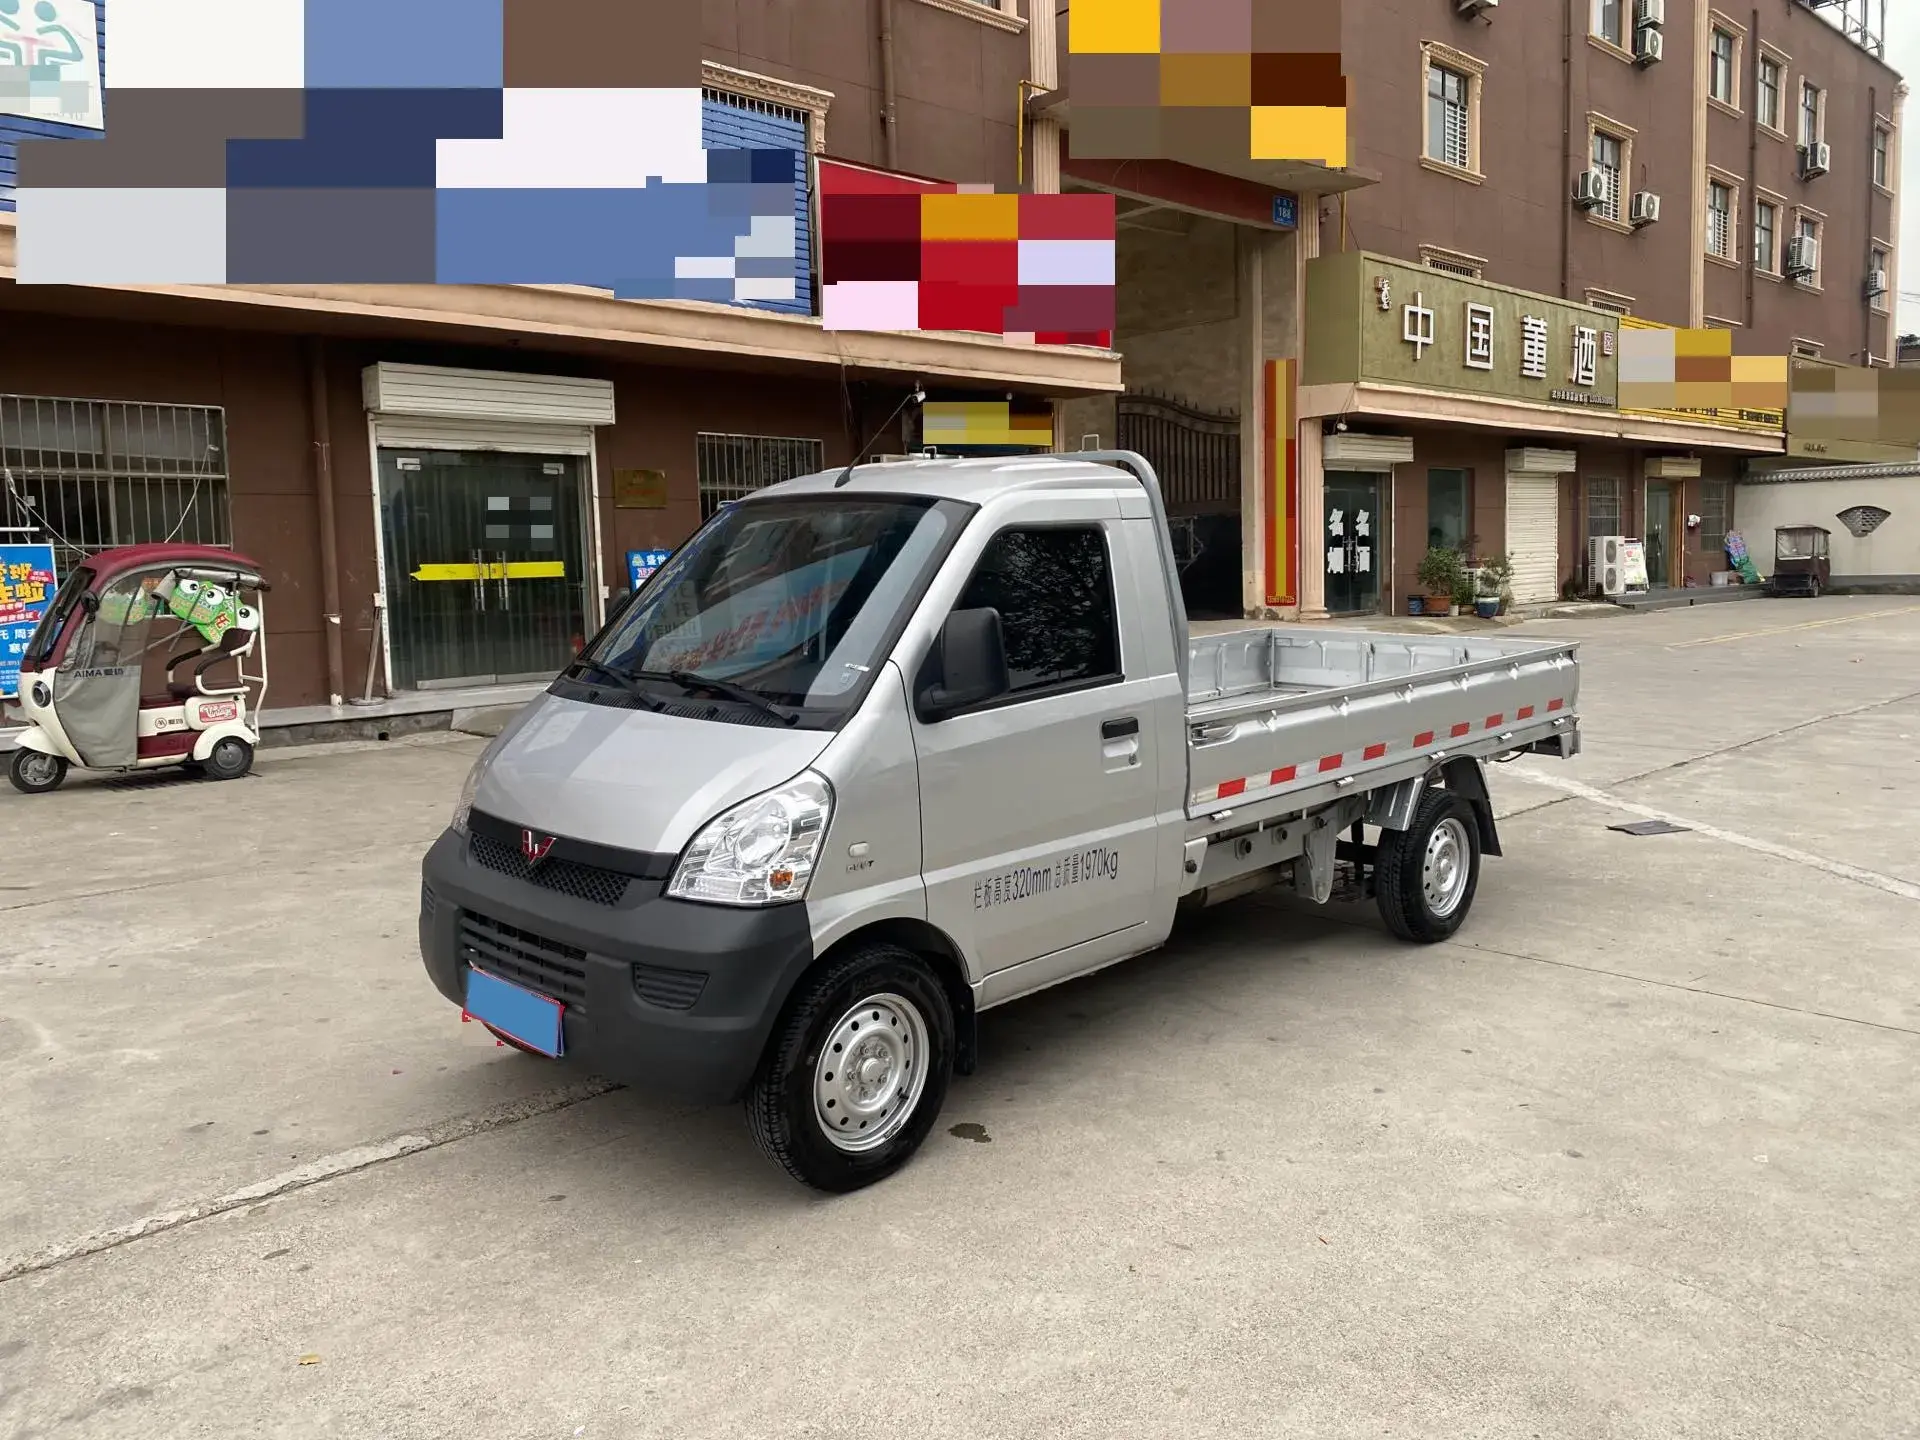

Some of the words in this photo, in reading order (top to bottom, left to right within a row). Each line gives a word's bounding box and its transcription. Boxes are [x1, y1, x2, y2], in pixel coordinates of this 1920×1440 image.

[1403, 291, 1597, 386] 中国董酒
[73, 669, 103, 679] AIMA
[973, 867, 1051, 912] 栏板高度320mm
[1054, 847, 1119, 889] 总质量1970kg
